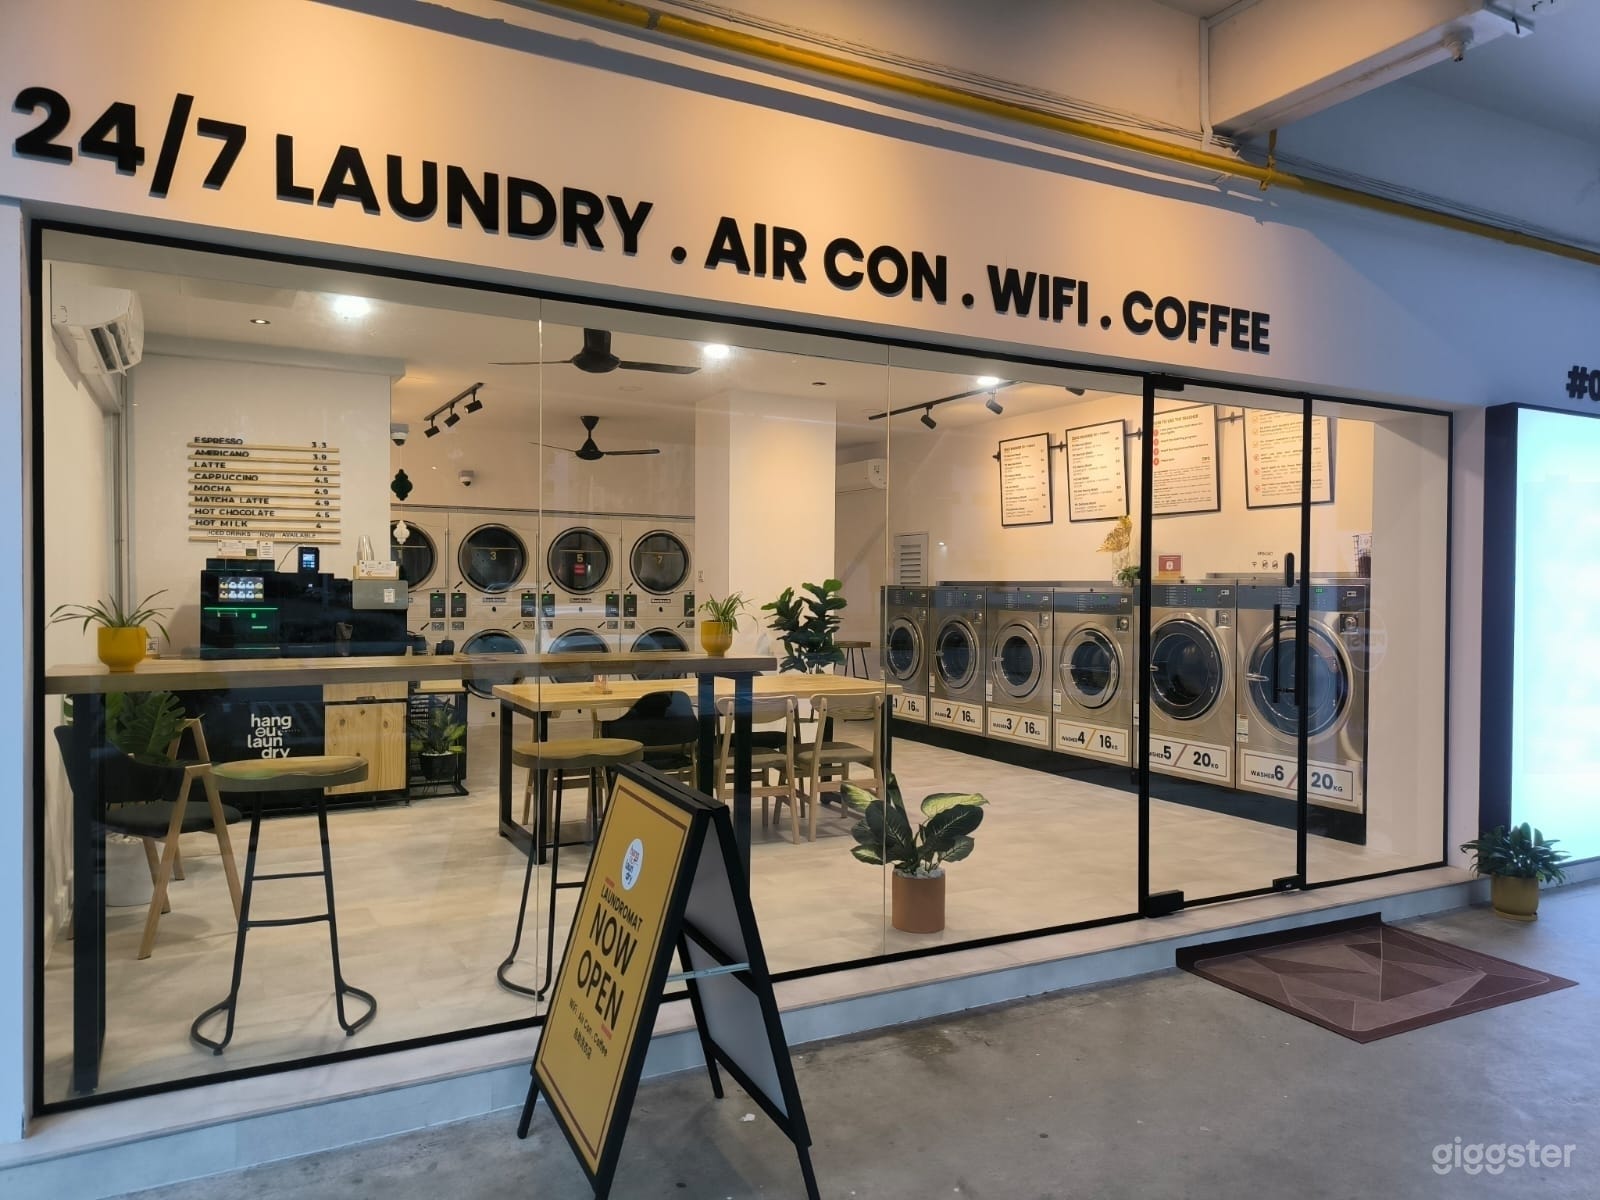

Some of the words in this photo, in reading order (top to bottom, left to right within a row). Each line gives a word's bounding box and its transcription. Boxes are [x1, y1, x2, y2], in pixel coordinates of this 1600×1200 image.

[13, 86, 246, 197] 24/7
[275, 133, 653, 255] LAUNDRY
[705, 216, 806, 282] AIR
[824, 238, 947, 302] CON
[987, 265, 1088, 326] WIFI
[1123, 291, 1270, 354] COFFEE
[194, 436, 243, 445] ESPRESSO
[490, 552, 496, 560] 3
[576, 554, 584, 562] 5
[946, 708, 952, 718] 2
[251, 713, 292, 730] hang
[1006, 718, 1012, 730] 3
[247, 734, 283, 748] laun
[1078, 731, 1085, 744] 4
[1164, 745, 1172, 760] 5
[1274, 764, 1284, 780] 6
[600, 885, 643, 932] LAUNDROMAT
[589, 903, 637, 976] NOW
[577, 951, 624, 1031] OPEN
